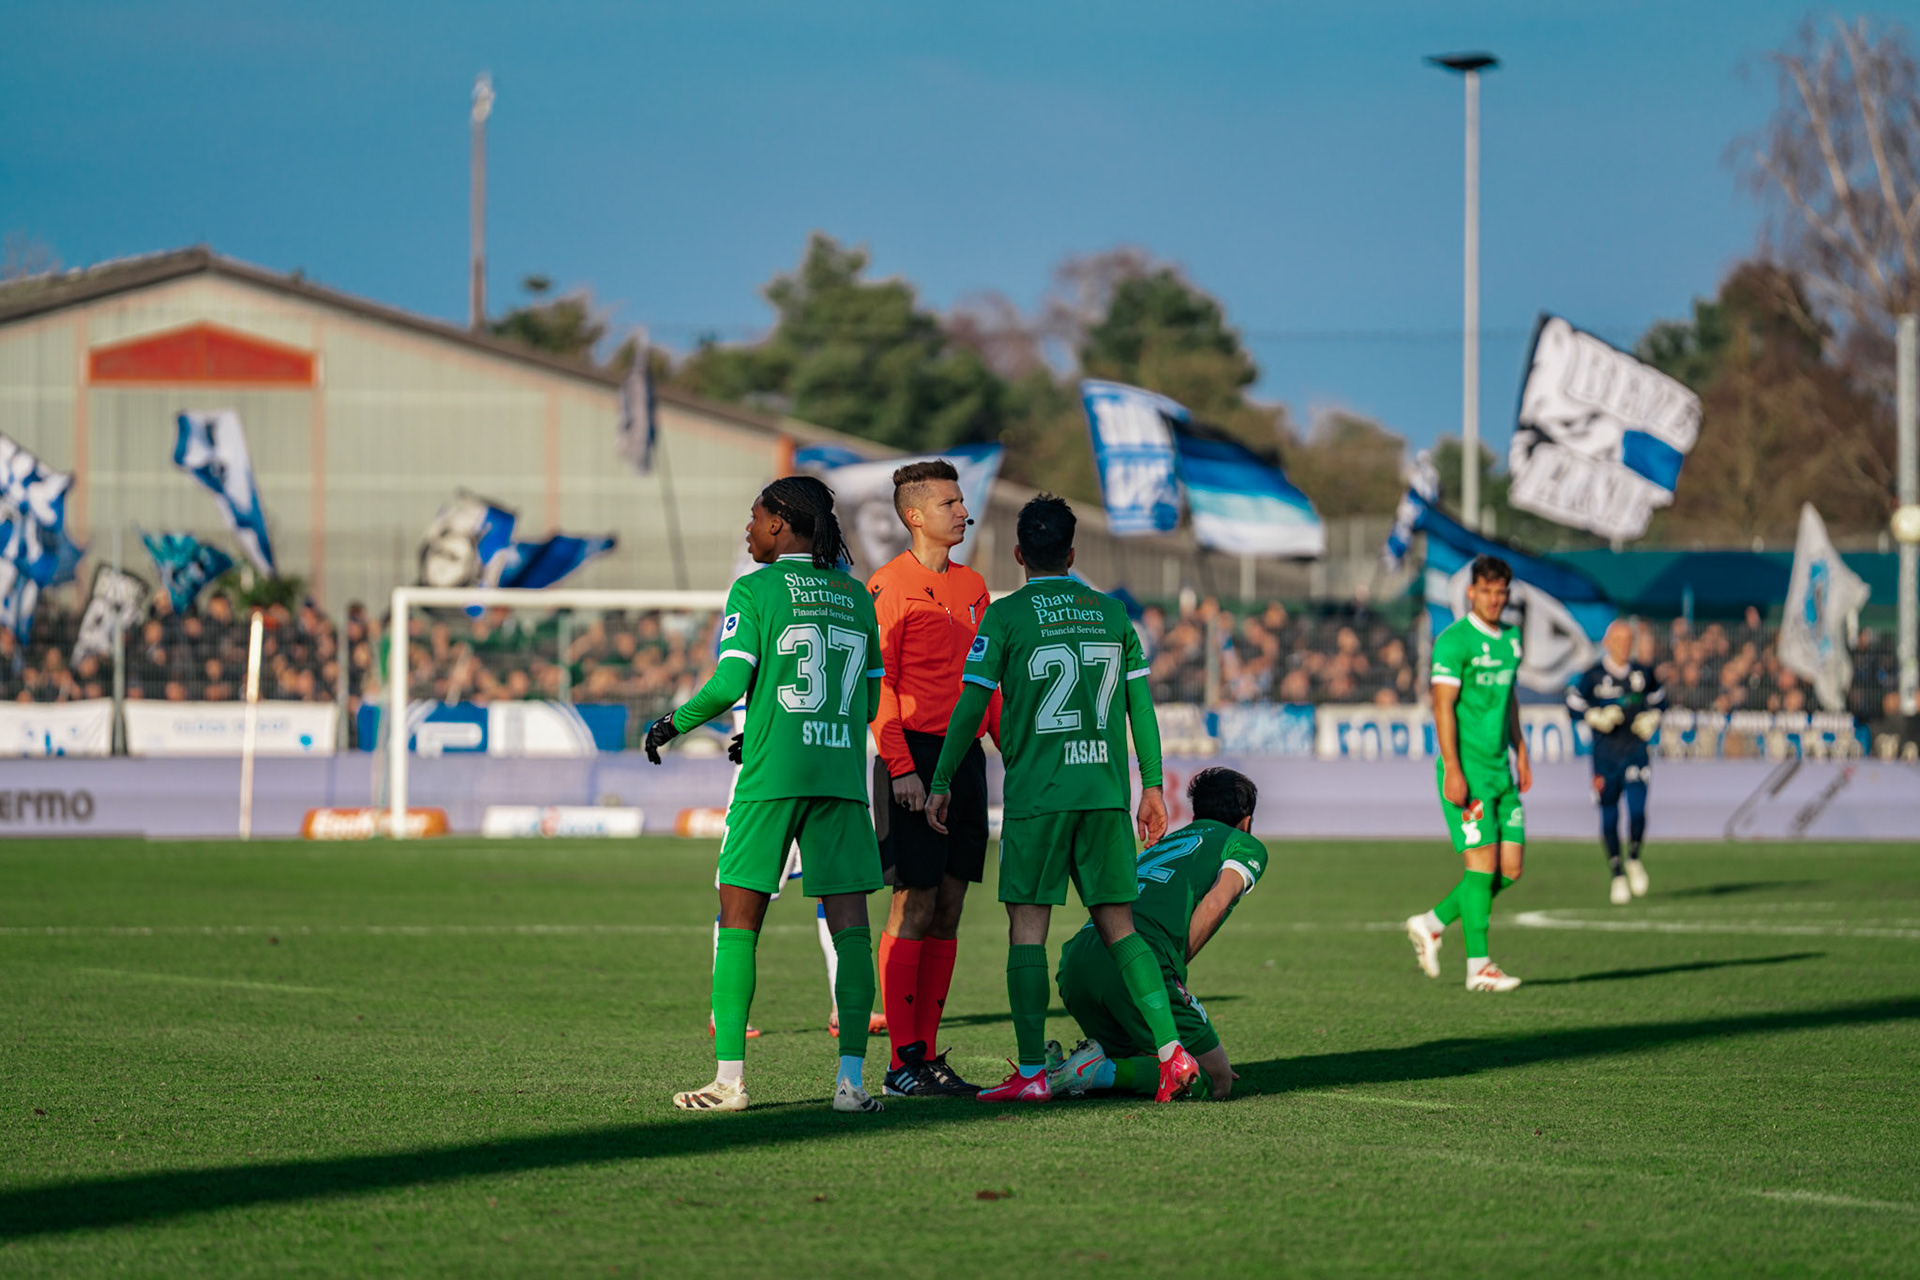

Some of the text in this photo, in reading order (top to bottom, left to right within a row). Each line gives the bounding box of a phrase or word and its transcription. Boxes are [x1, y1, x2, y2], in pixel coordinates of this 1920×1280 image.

[784, 572, 829, 588] Shaw
[788, 587, 855, 609] Partners
[1031, 594, 1074, 609] Shaw
[793, 607, 855, 622] Financial Services
[1035, 607, 1104, 625] Partners
[1041, 625, 1107, 638] Financial Services
[777, 623, 868, 717] 37
[1028, 641, 1123, 734] 27
[802, 720, 851, 749] SYLLA
[1064, 740, 1109, 765] TASAR
[1136, 834, 1203, 884] 2
